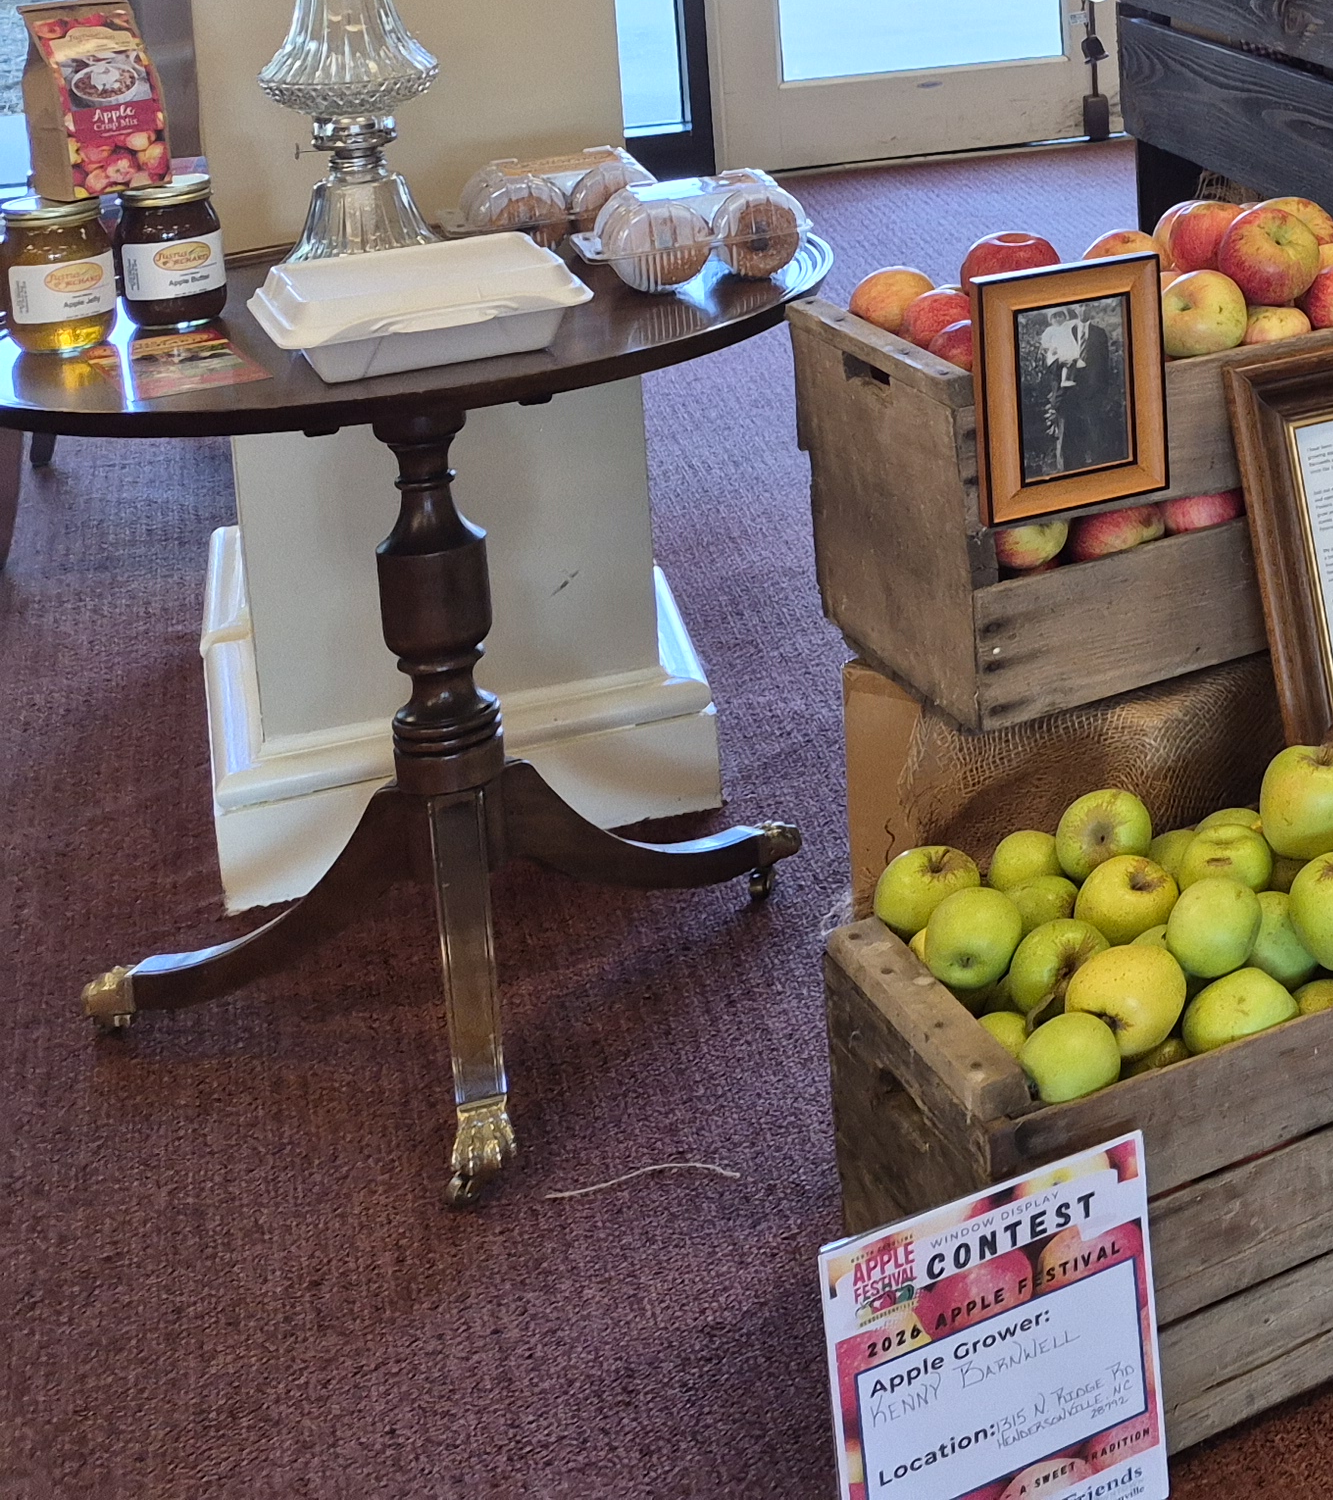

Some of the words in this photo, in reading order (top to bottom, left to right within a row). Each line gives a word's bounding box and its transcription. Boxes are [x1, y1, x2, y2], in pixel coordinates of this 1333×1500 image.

[92, 104, 135, 125] Apple
[93, 120, 118, 133] Crisp
[120, 116, 138, 127] Mix
[63, 299, 84, 309] Apple
[169, 277, 188, 287] Apple
[190, 273, 210, 284] Butter
[926, 1191, 1096, 1280] CONTEST
[930, 1216, 995, 1249] WINDOW
[1000, 1191, 1060, 1221] DISPLAY
[853, 1241, 916, 1286] APPLE
[854, 1265, 917, 1304] FESTIVAL
[866, 1323, 923, 1359] 2026
[935, 1286, 1005, 1330] APPLE
[1017, 1240, 1122, 1295] FESTIVAL
[869, 1354, 946, 1398] Apple
[953, 1308, 1051, 1360] Grower:
[870, 1371, 942, 1428] KENNY
[953, 1330, 1081, 1390] BARNWELL
[1112, 1378, 1134, 1397] NC
[995, 1409, 1027, 1434] 1315
[1051, 1378, 1105, 1406] RIDGE
[1090, 1396, 1129, 1419] 28792
[878, 1423, 996, 1487] Location:
[1018, 1484, 1028, 1497] A
[1034, 1461, 1076, 1489] SWEET
[1084, 1426, 1150, 1465] TRADITION
